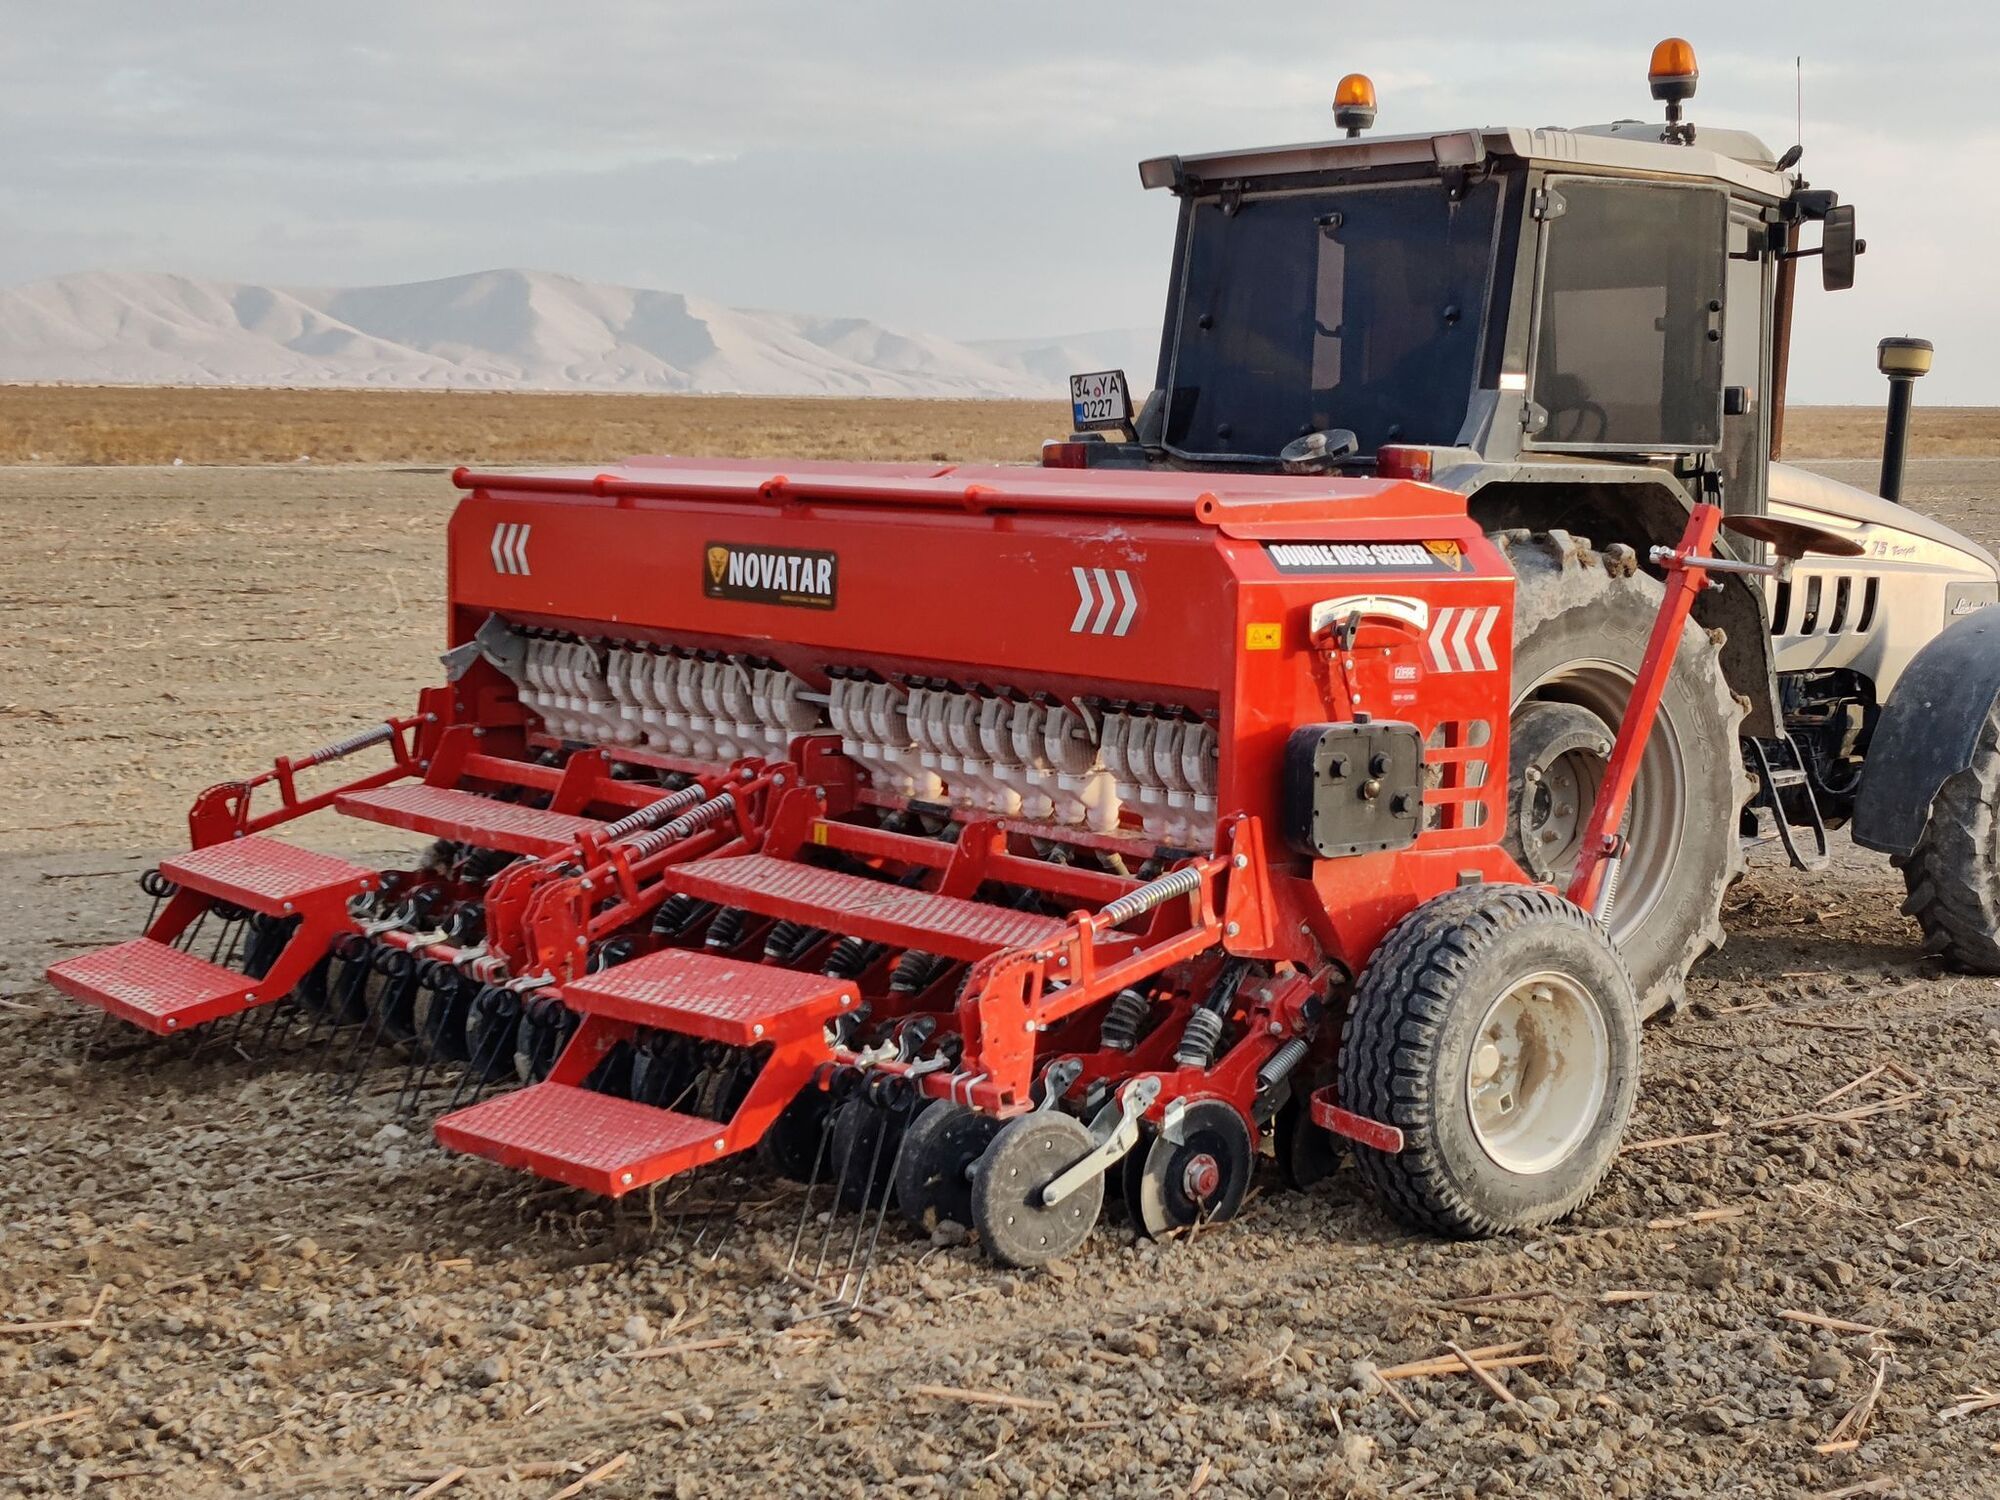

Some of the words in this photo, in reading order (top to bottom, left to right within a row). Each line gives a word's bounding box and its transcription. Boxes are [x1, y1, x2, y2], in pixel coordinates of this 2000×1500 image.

[1075, 379, 1090, 398] 34
[1099, 376, 1119, 395] YA
[1082, 399, 1113, 419] 0227
[1268, 544, 1338, 566] DOUBLE
[1329, 544, 1377, 566] DISC
[1369, 544, 1434, 565] SEEDER
[728, 551, 832, 595] NOVATAR
